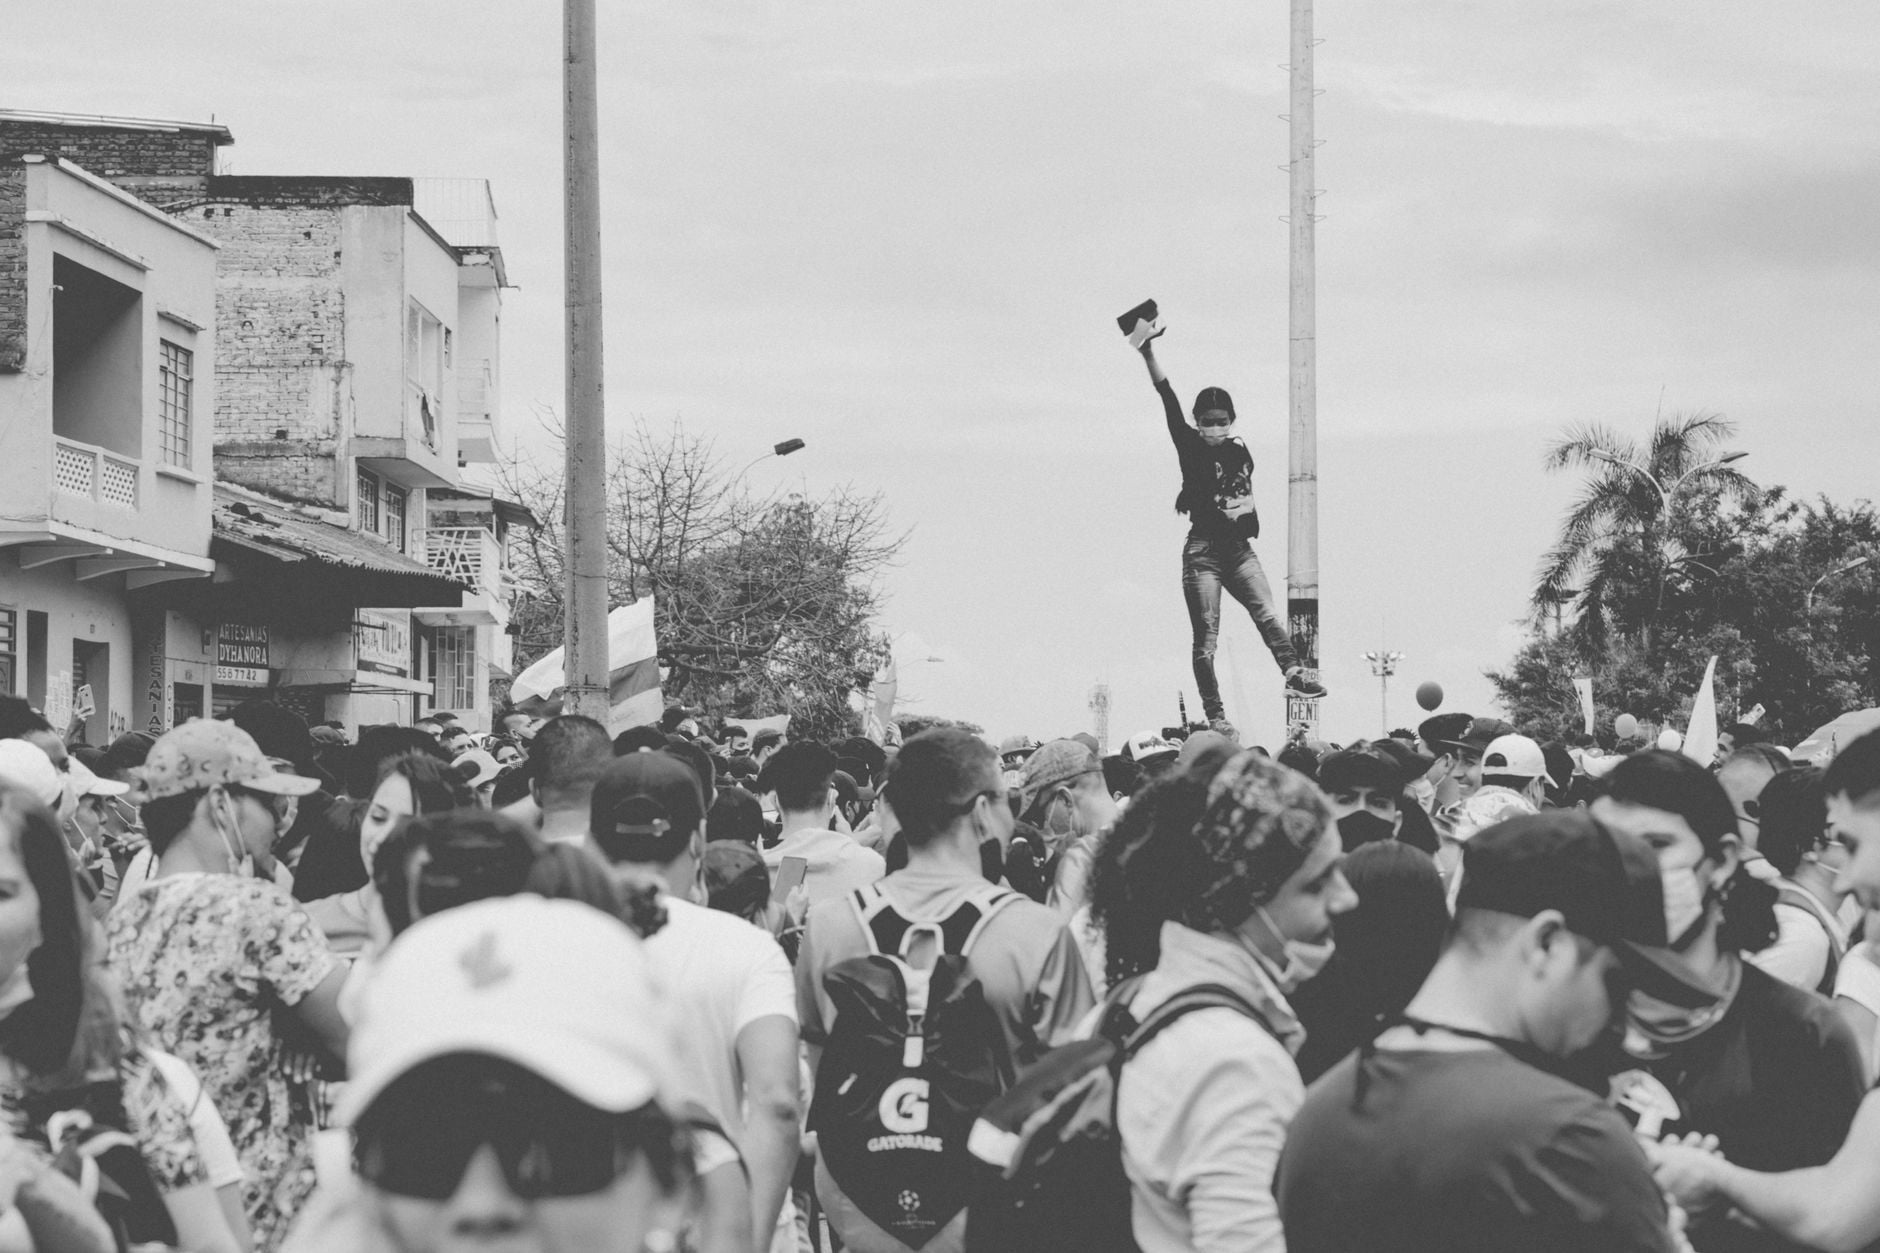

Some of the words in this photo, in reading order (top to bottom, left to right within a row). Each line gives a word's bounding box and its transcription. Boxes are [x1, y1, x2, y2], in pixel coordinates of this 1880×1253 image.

[219, 623, 267, 643] ARTESANIAS
[219, 643, 267, 665] DYHANORA
[879, 1077, 930, 1133] G
[867, 1134, 943, 1152] GATORADE
